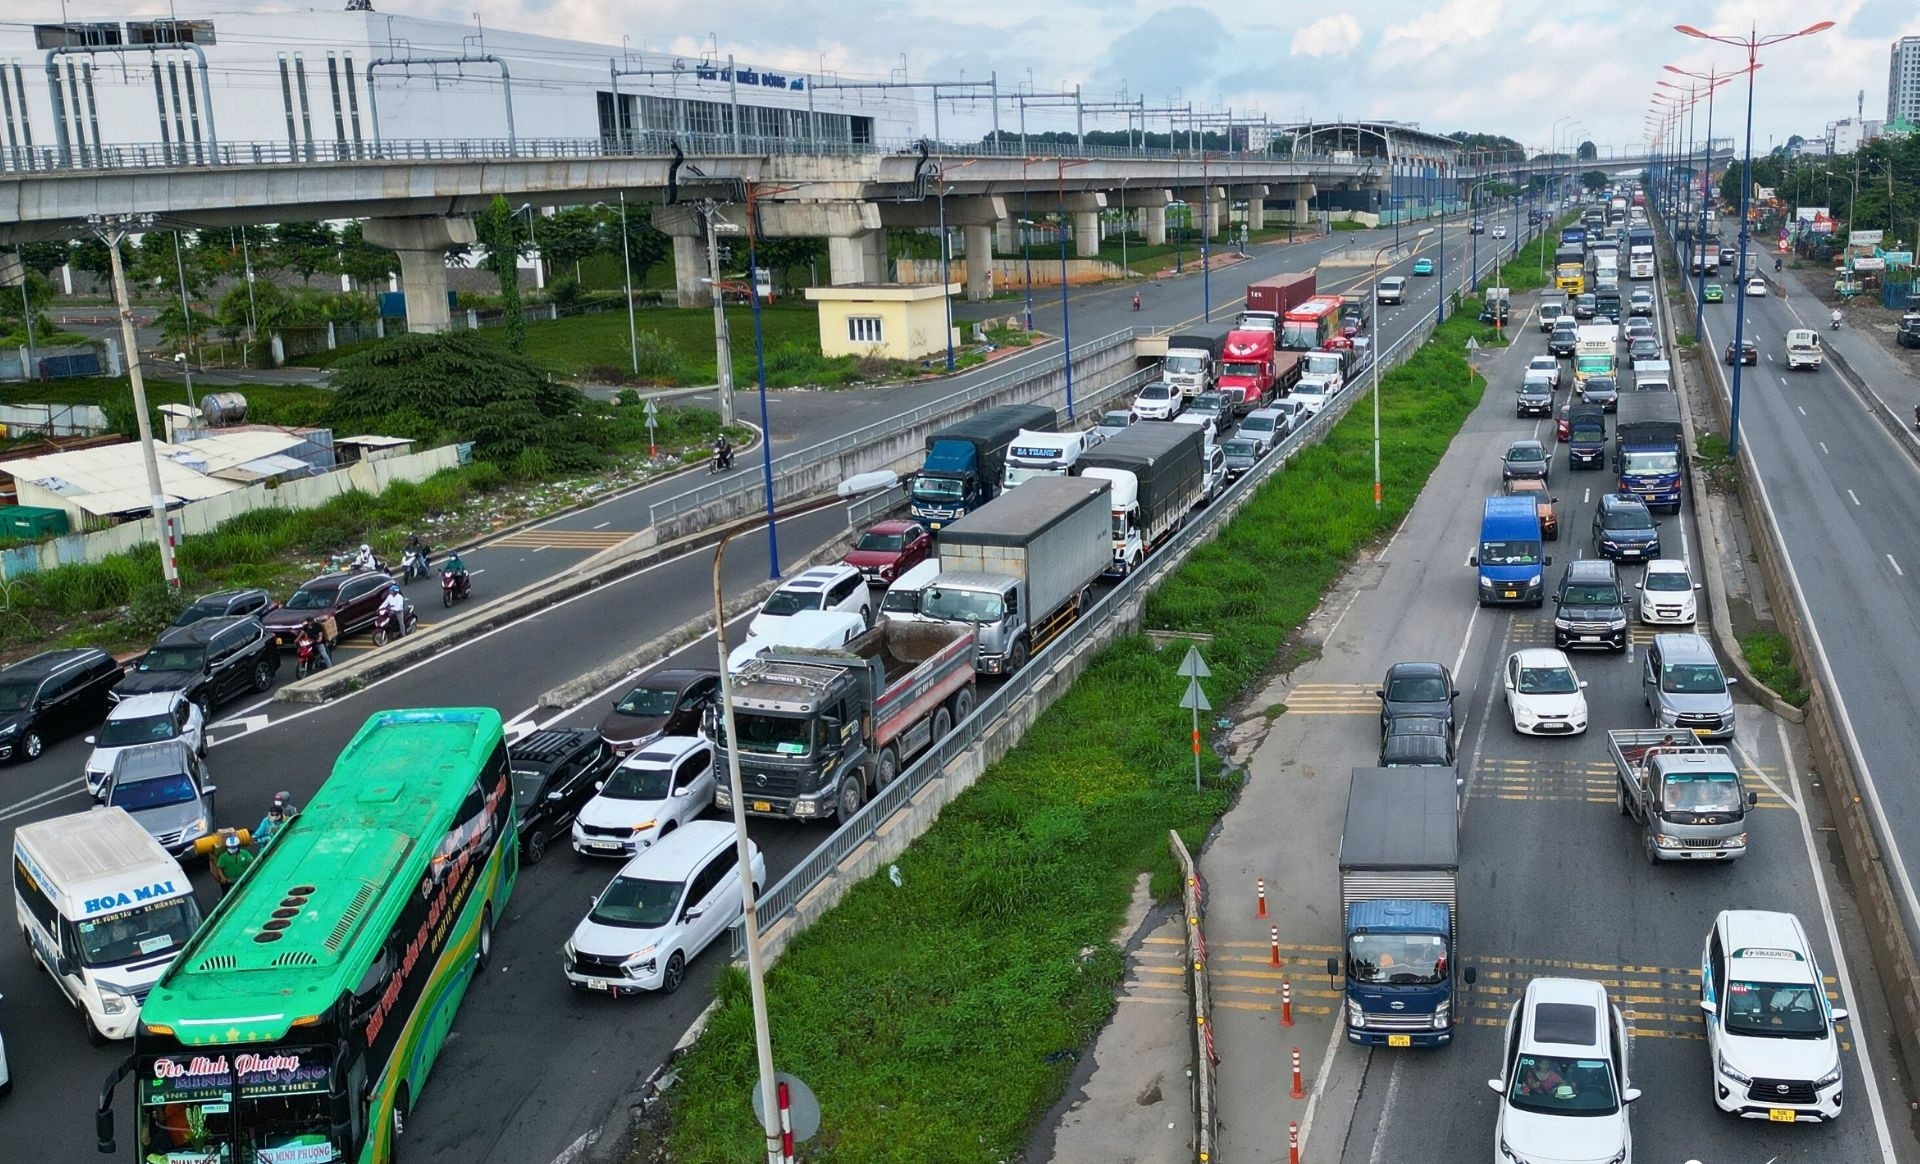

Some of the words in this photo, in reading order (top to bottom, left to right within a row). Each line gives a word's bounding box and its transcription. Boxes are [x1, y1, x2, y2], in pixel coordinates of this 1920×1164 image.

[736, 67, 759, 85] MIỀN
[762, 72, 786, 89] ĐÔNG
[84, 892, 132, 913] HOA
[133, 881, 175, 901] MAI
[185, 1055, 229, 1076] Minh
[234, 1053, 300, 1077] Phượng
[241, 1085, 276, 1093] PHAN
[276, 1150, 295, 1160] MINH
